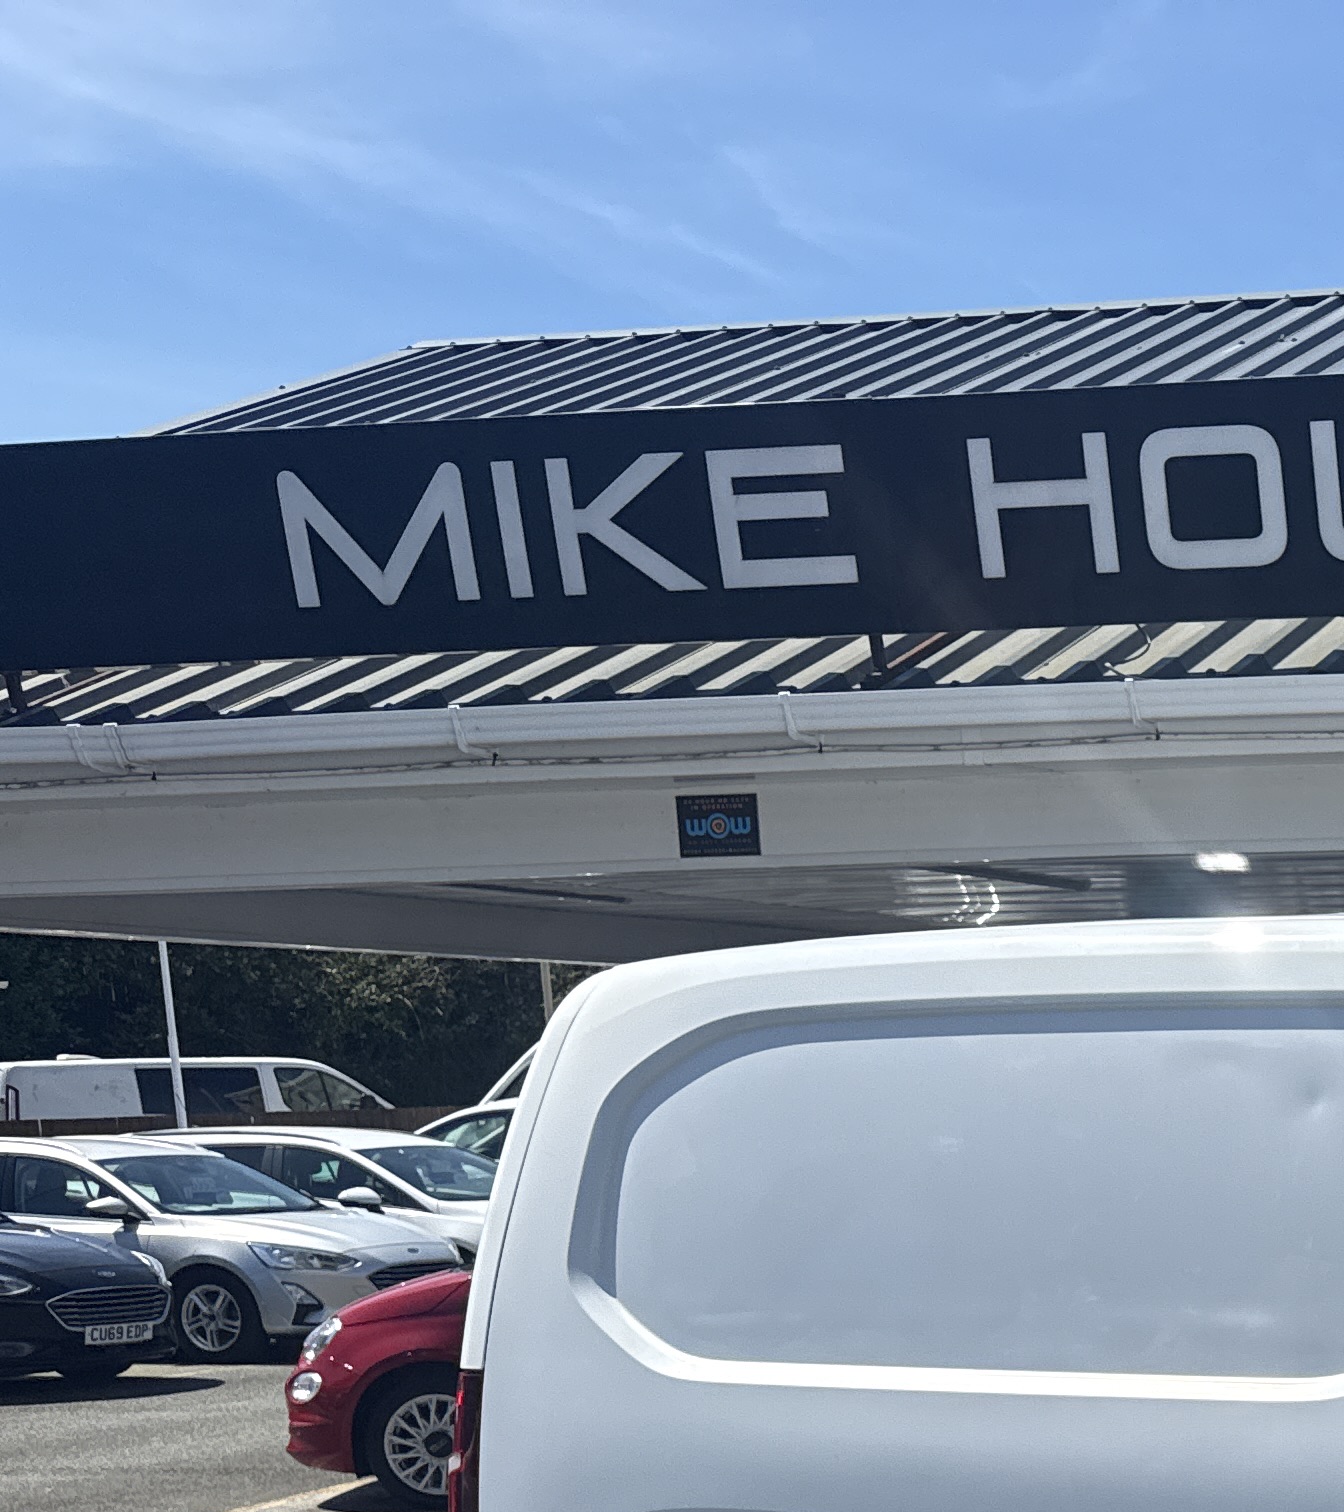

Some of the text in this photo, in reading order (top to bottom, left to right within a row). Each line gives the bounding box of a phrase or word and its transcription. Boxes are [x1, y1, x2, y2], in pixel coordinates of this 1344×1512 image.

[276, 444, 859, 609] MIKE
[90, 1323, 149, 1341] CU69 EDP
